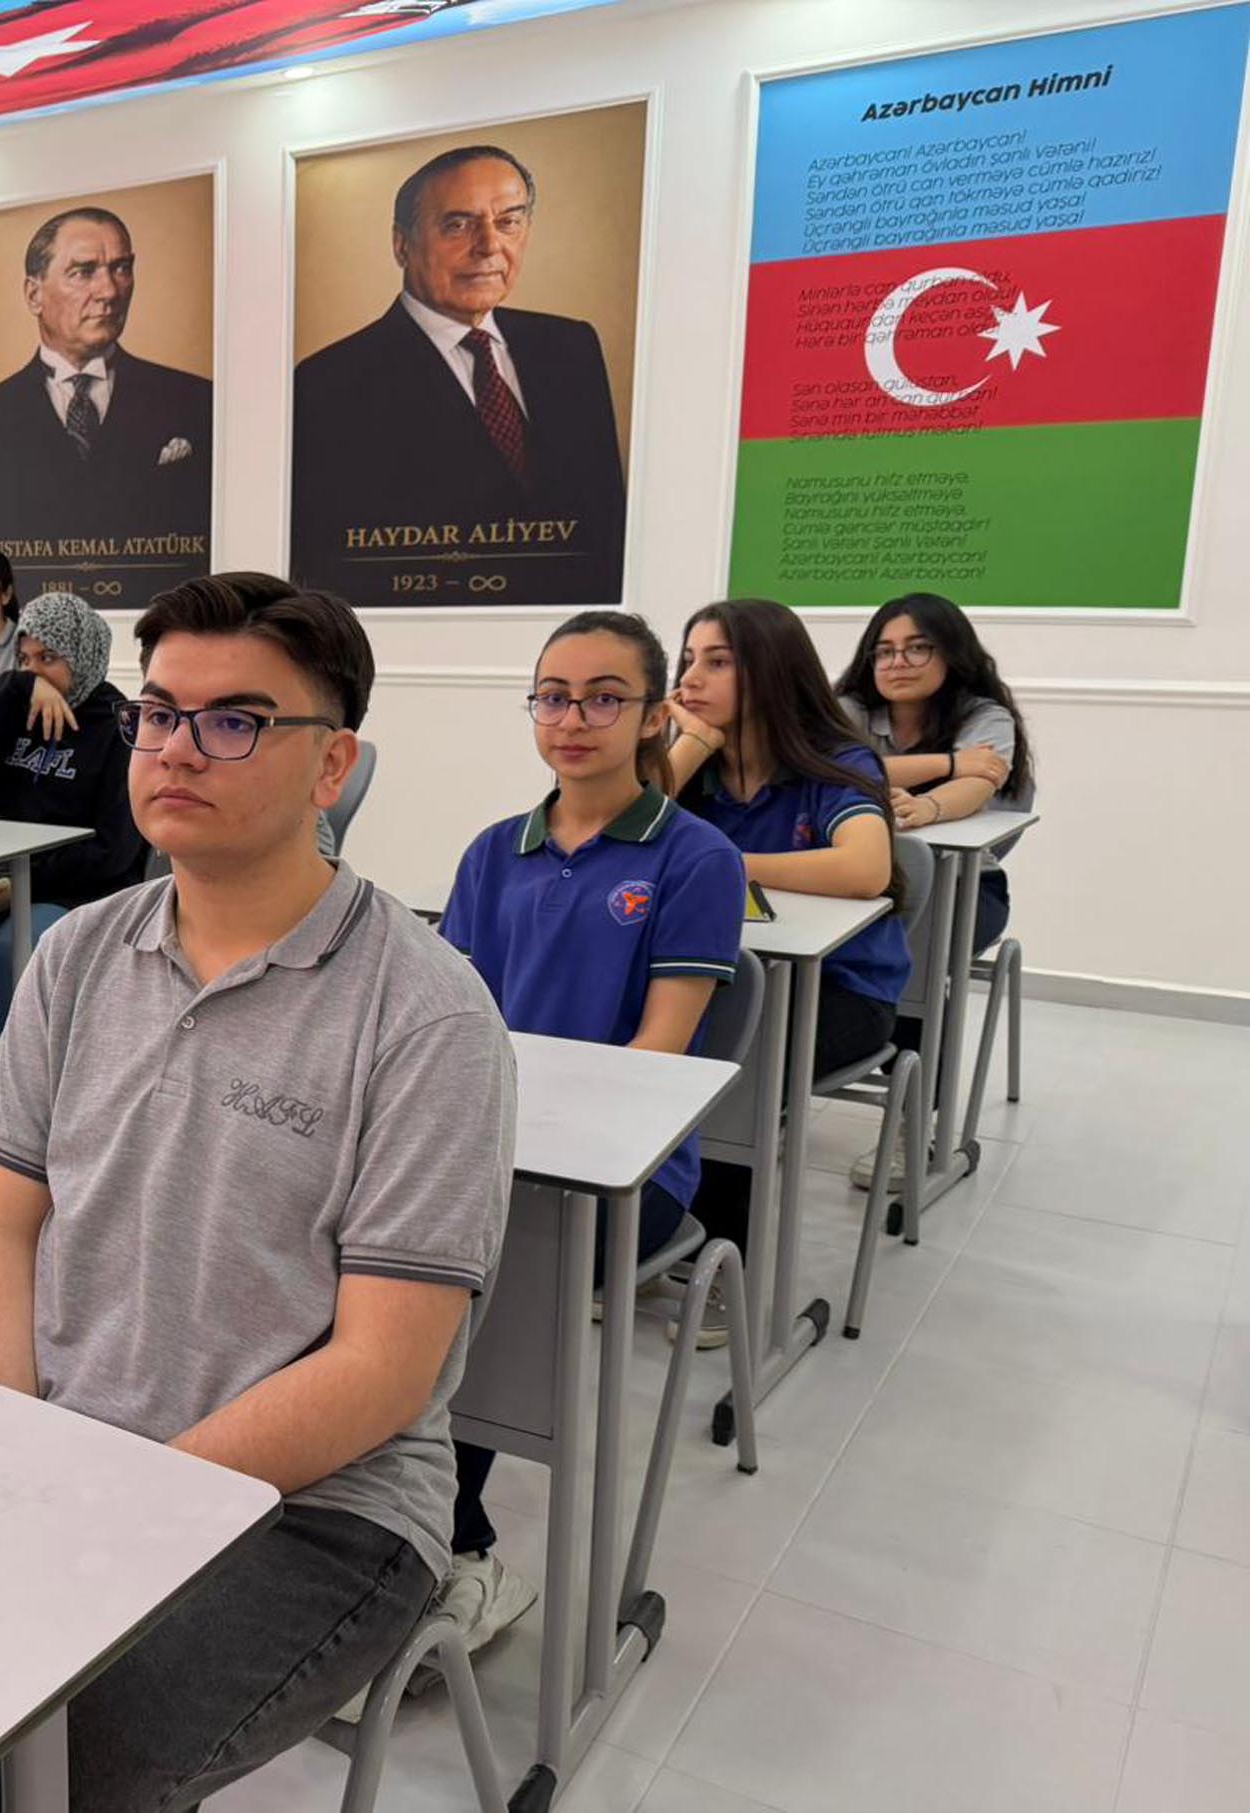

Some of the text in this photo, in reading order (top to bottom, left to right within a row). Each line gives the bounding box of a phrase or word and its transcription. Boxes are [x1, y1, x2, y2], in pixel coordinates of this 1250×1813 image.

[861, 64, 1114, 123] Azərbaycan Himni
[915, 128, 1028, 158] Azərbaycan!
[807, 173, 828, 190] Ey
[911, 176, 944, 192] can
[57, 537, 120, 558] KEMAL
[123, 532, 207, 555] ATATÜRK
[347, 518, 579, 549] HAYDAR ALİYEV
[391, 574, 439, 592] 1923
